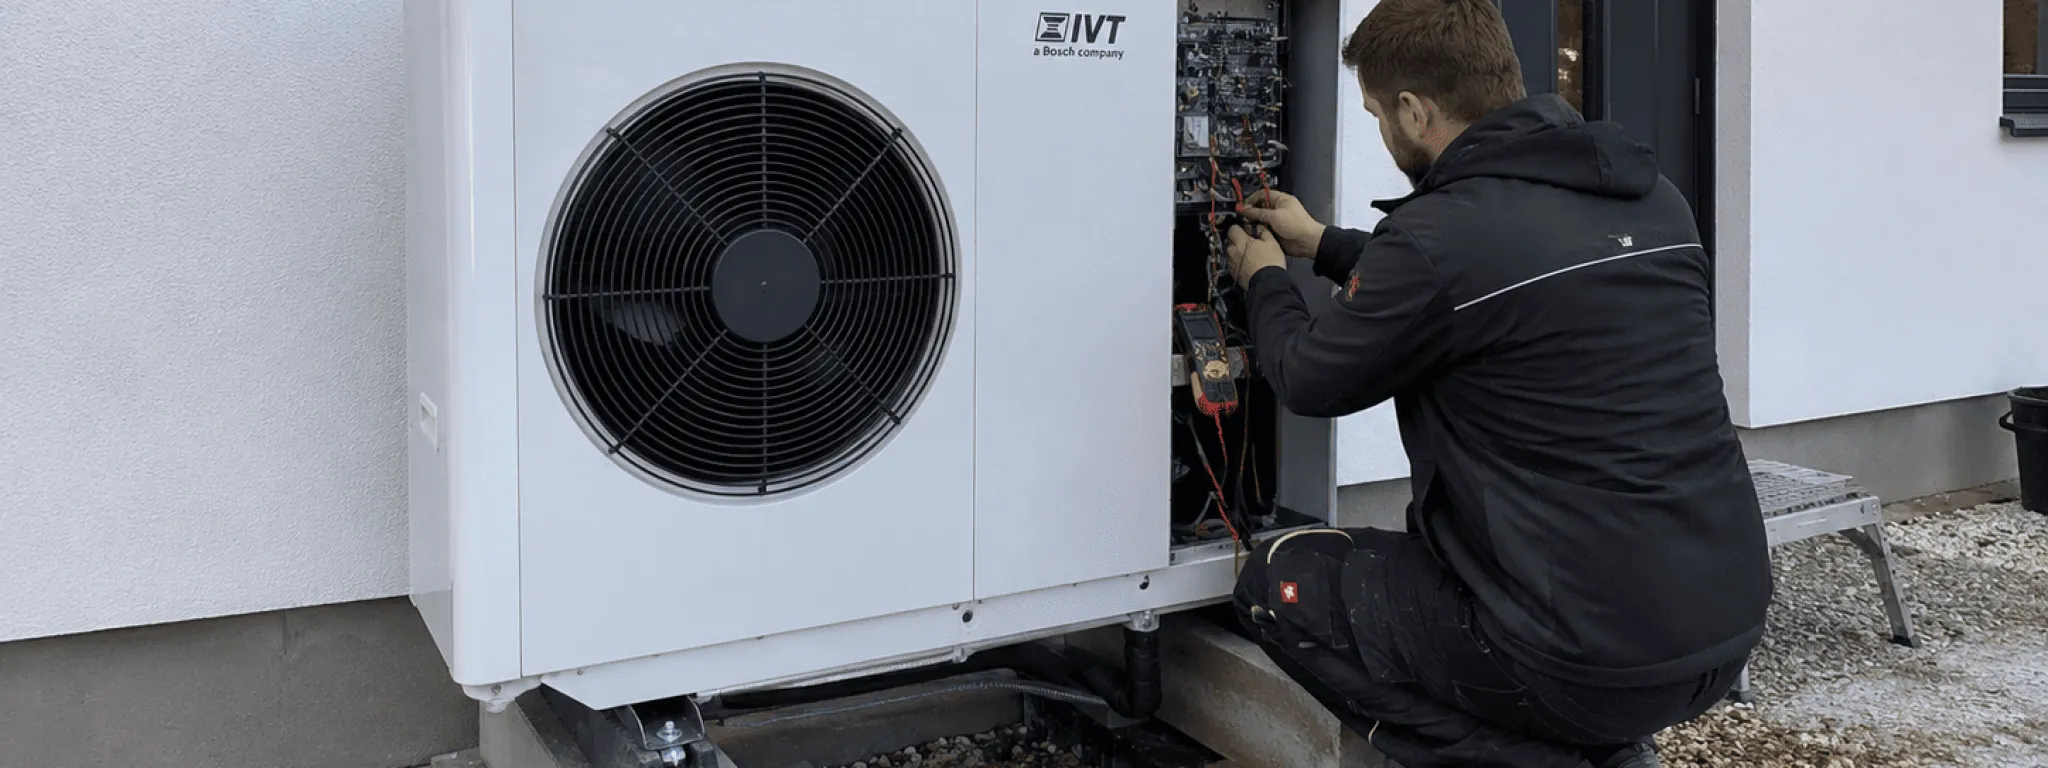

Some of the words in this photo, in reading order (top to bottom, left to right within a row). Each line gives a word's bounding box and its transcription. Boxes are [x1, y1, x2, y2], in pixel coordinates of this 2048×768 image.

[1071, 14, 1126, 44] IVT
[1033, 47, 1040, 56] a
[1043, 46, 1075, 57] Bosch
[1077, 48, 1124, 60] company
